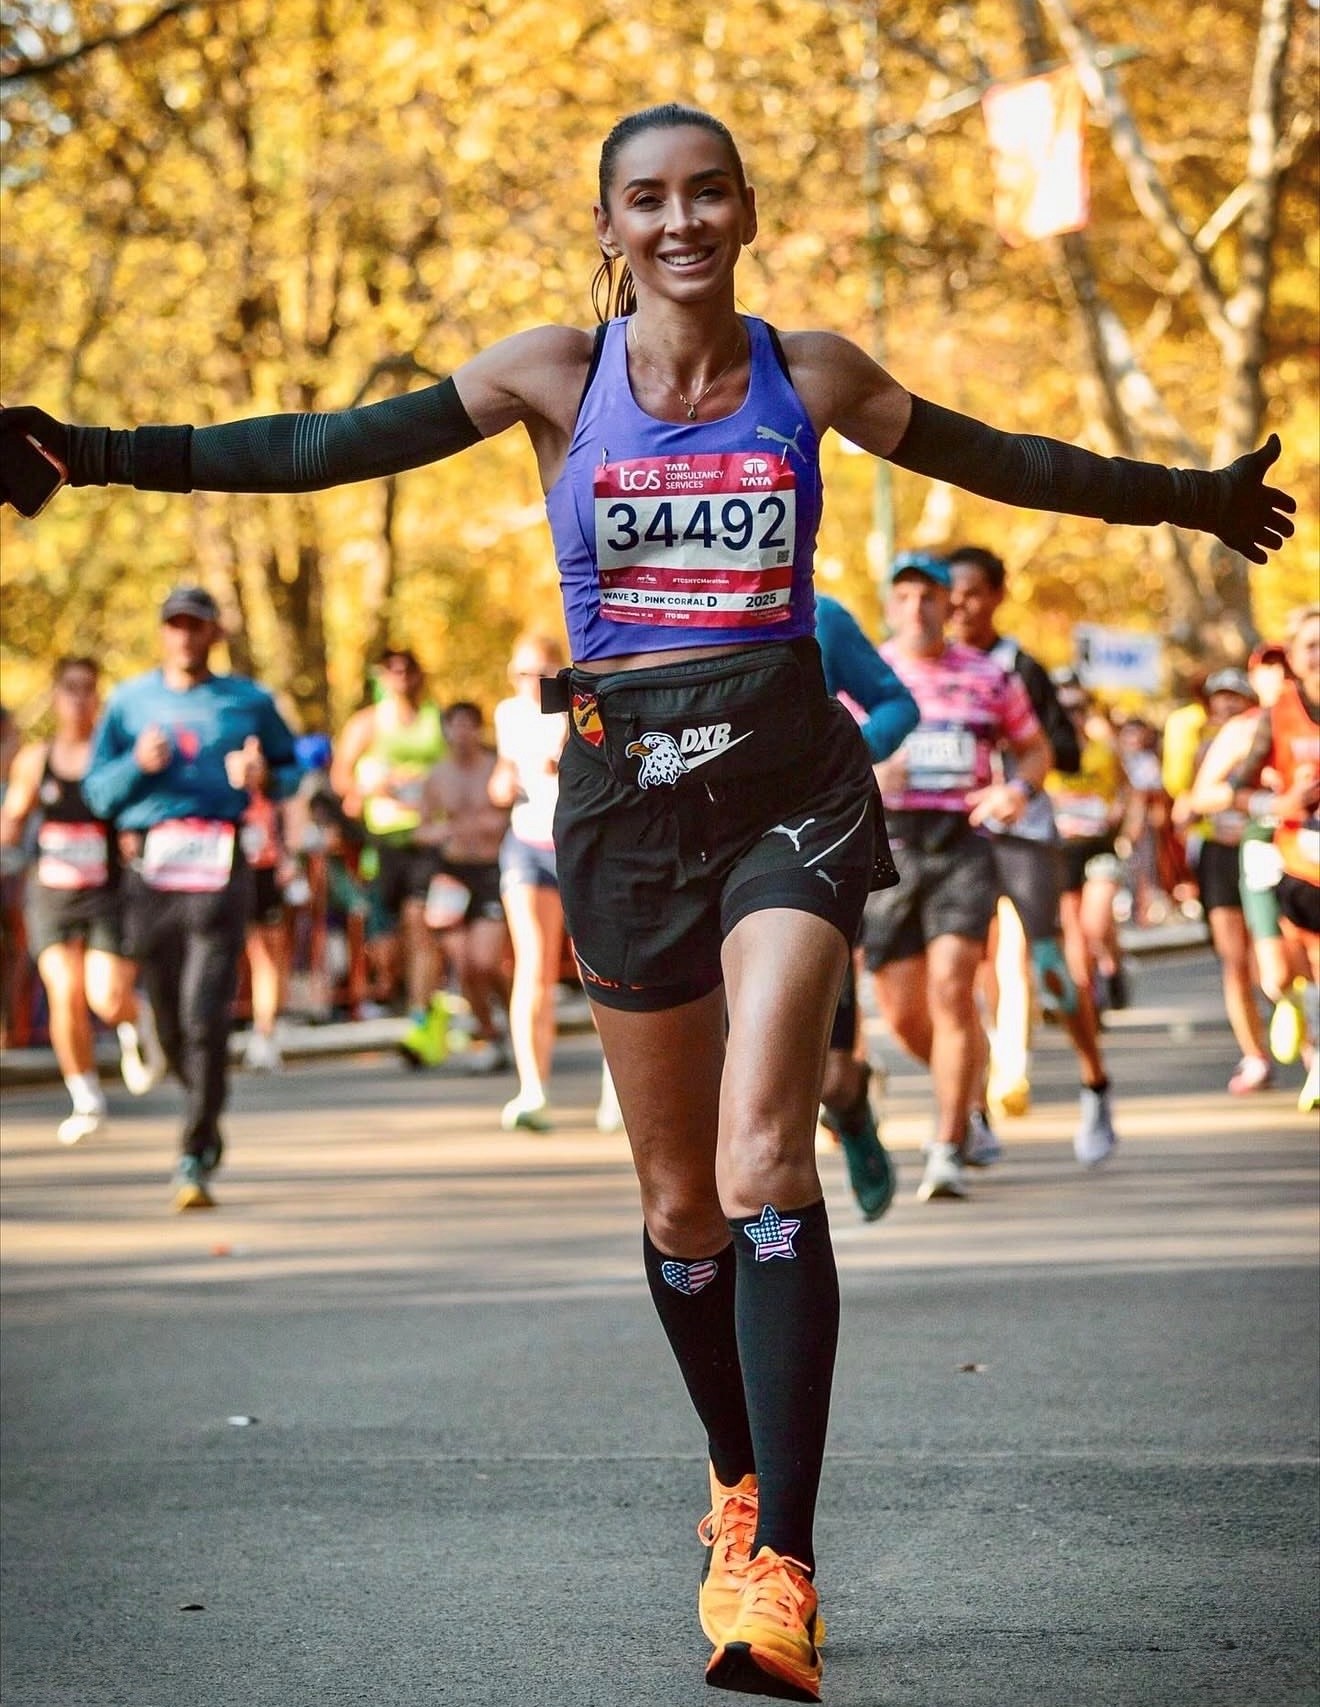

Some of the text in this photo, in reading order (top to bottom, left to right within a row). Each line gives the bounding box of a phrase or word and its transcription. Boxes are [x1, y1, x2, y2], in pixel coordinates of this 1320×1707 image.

[664, 463, 690, 471] TATA
[665, 471, 724, 480] CONSULTANCY
[665, 481, 704, 490] SERVICES
[740, 476, 773, 486] TATA
[607, 497, 786, 551] 34492
[603, 592, 777, 608] WAVE 3 PINK CORRAL D 2025
[680, 722, 731, 753] DXB
